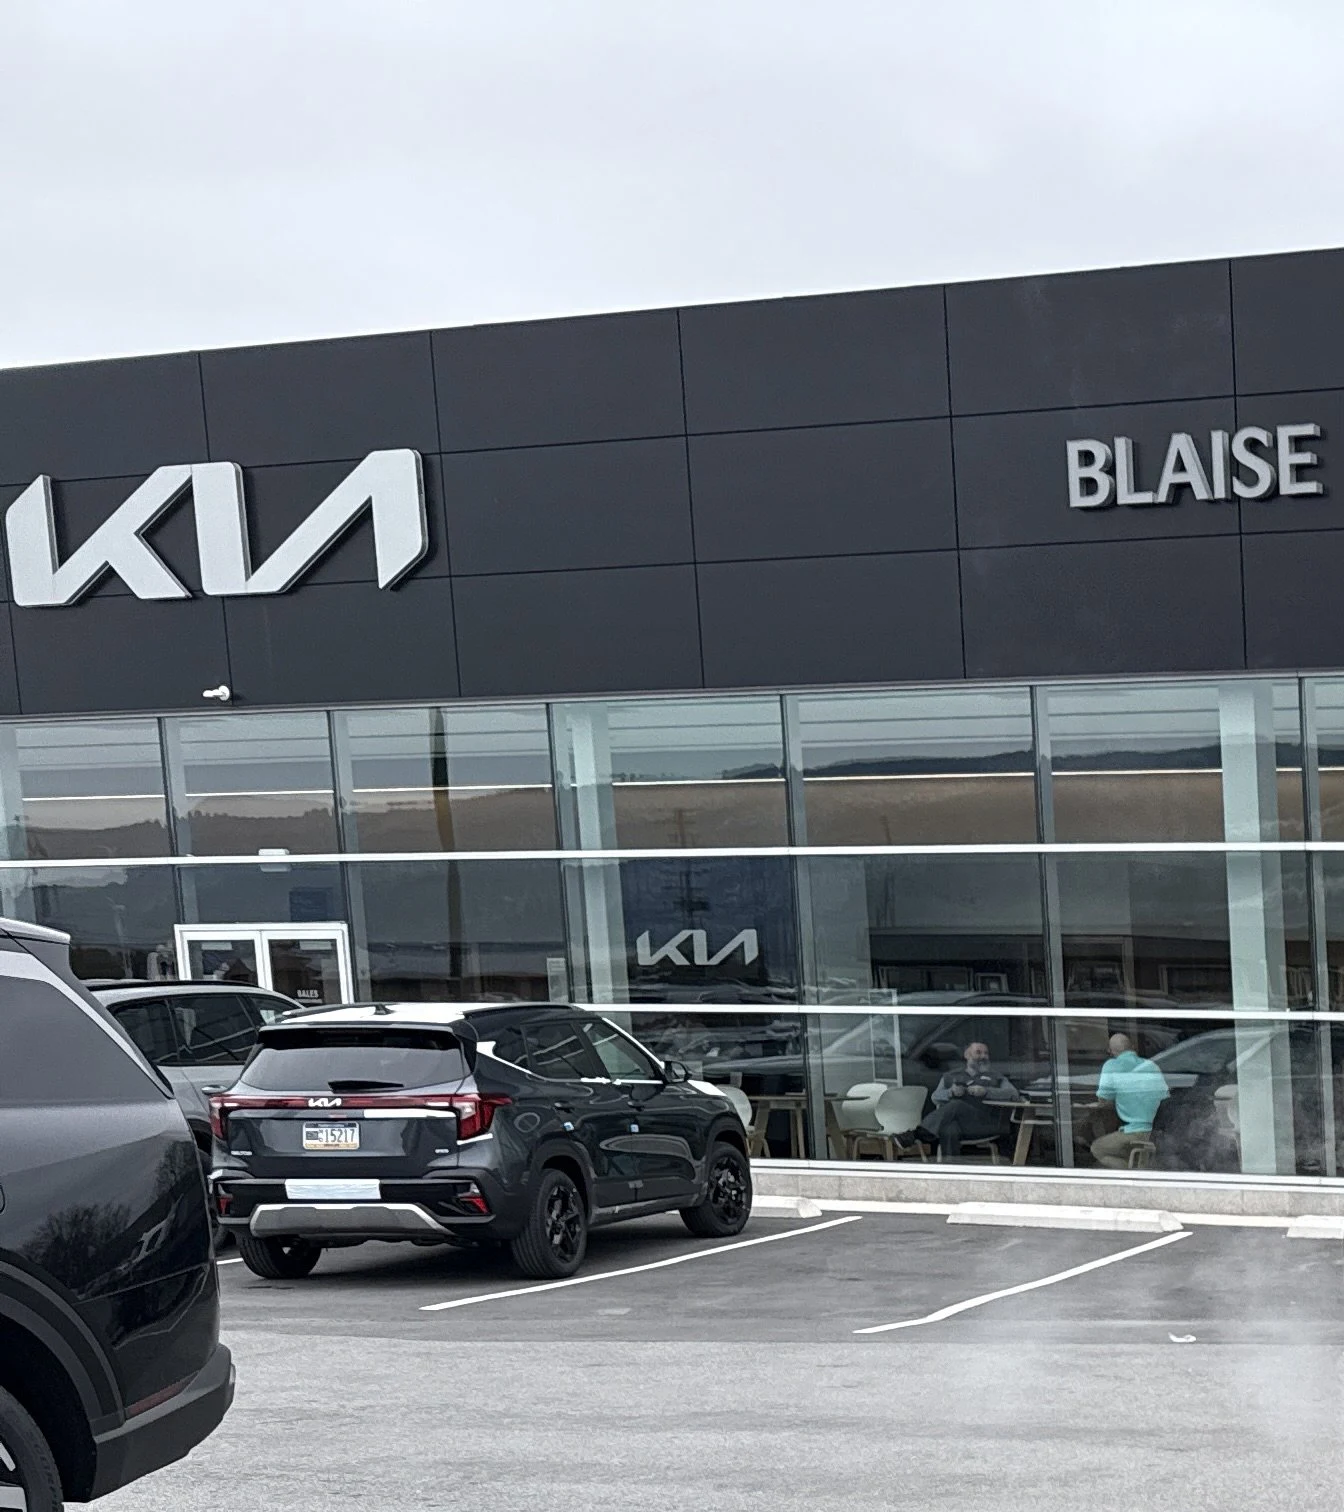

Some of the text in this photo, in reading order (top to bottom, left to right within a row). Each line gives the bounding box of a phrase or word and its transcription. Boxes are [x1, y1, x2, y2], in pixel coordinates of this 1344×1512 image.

[1066, 423, 1324, 508] BLAISE
[5, 448, 428, 607] KIA
[636, 928, 759, 966] KIA
[308, 1097, 342, 1107] KIA
[324, 1128, 355, 1143] 15217
